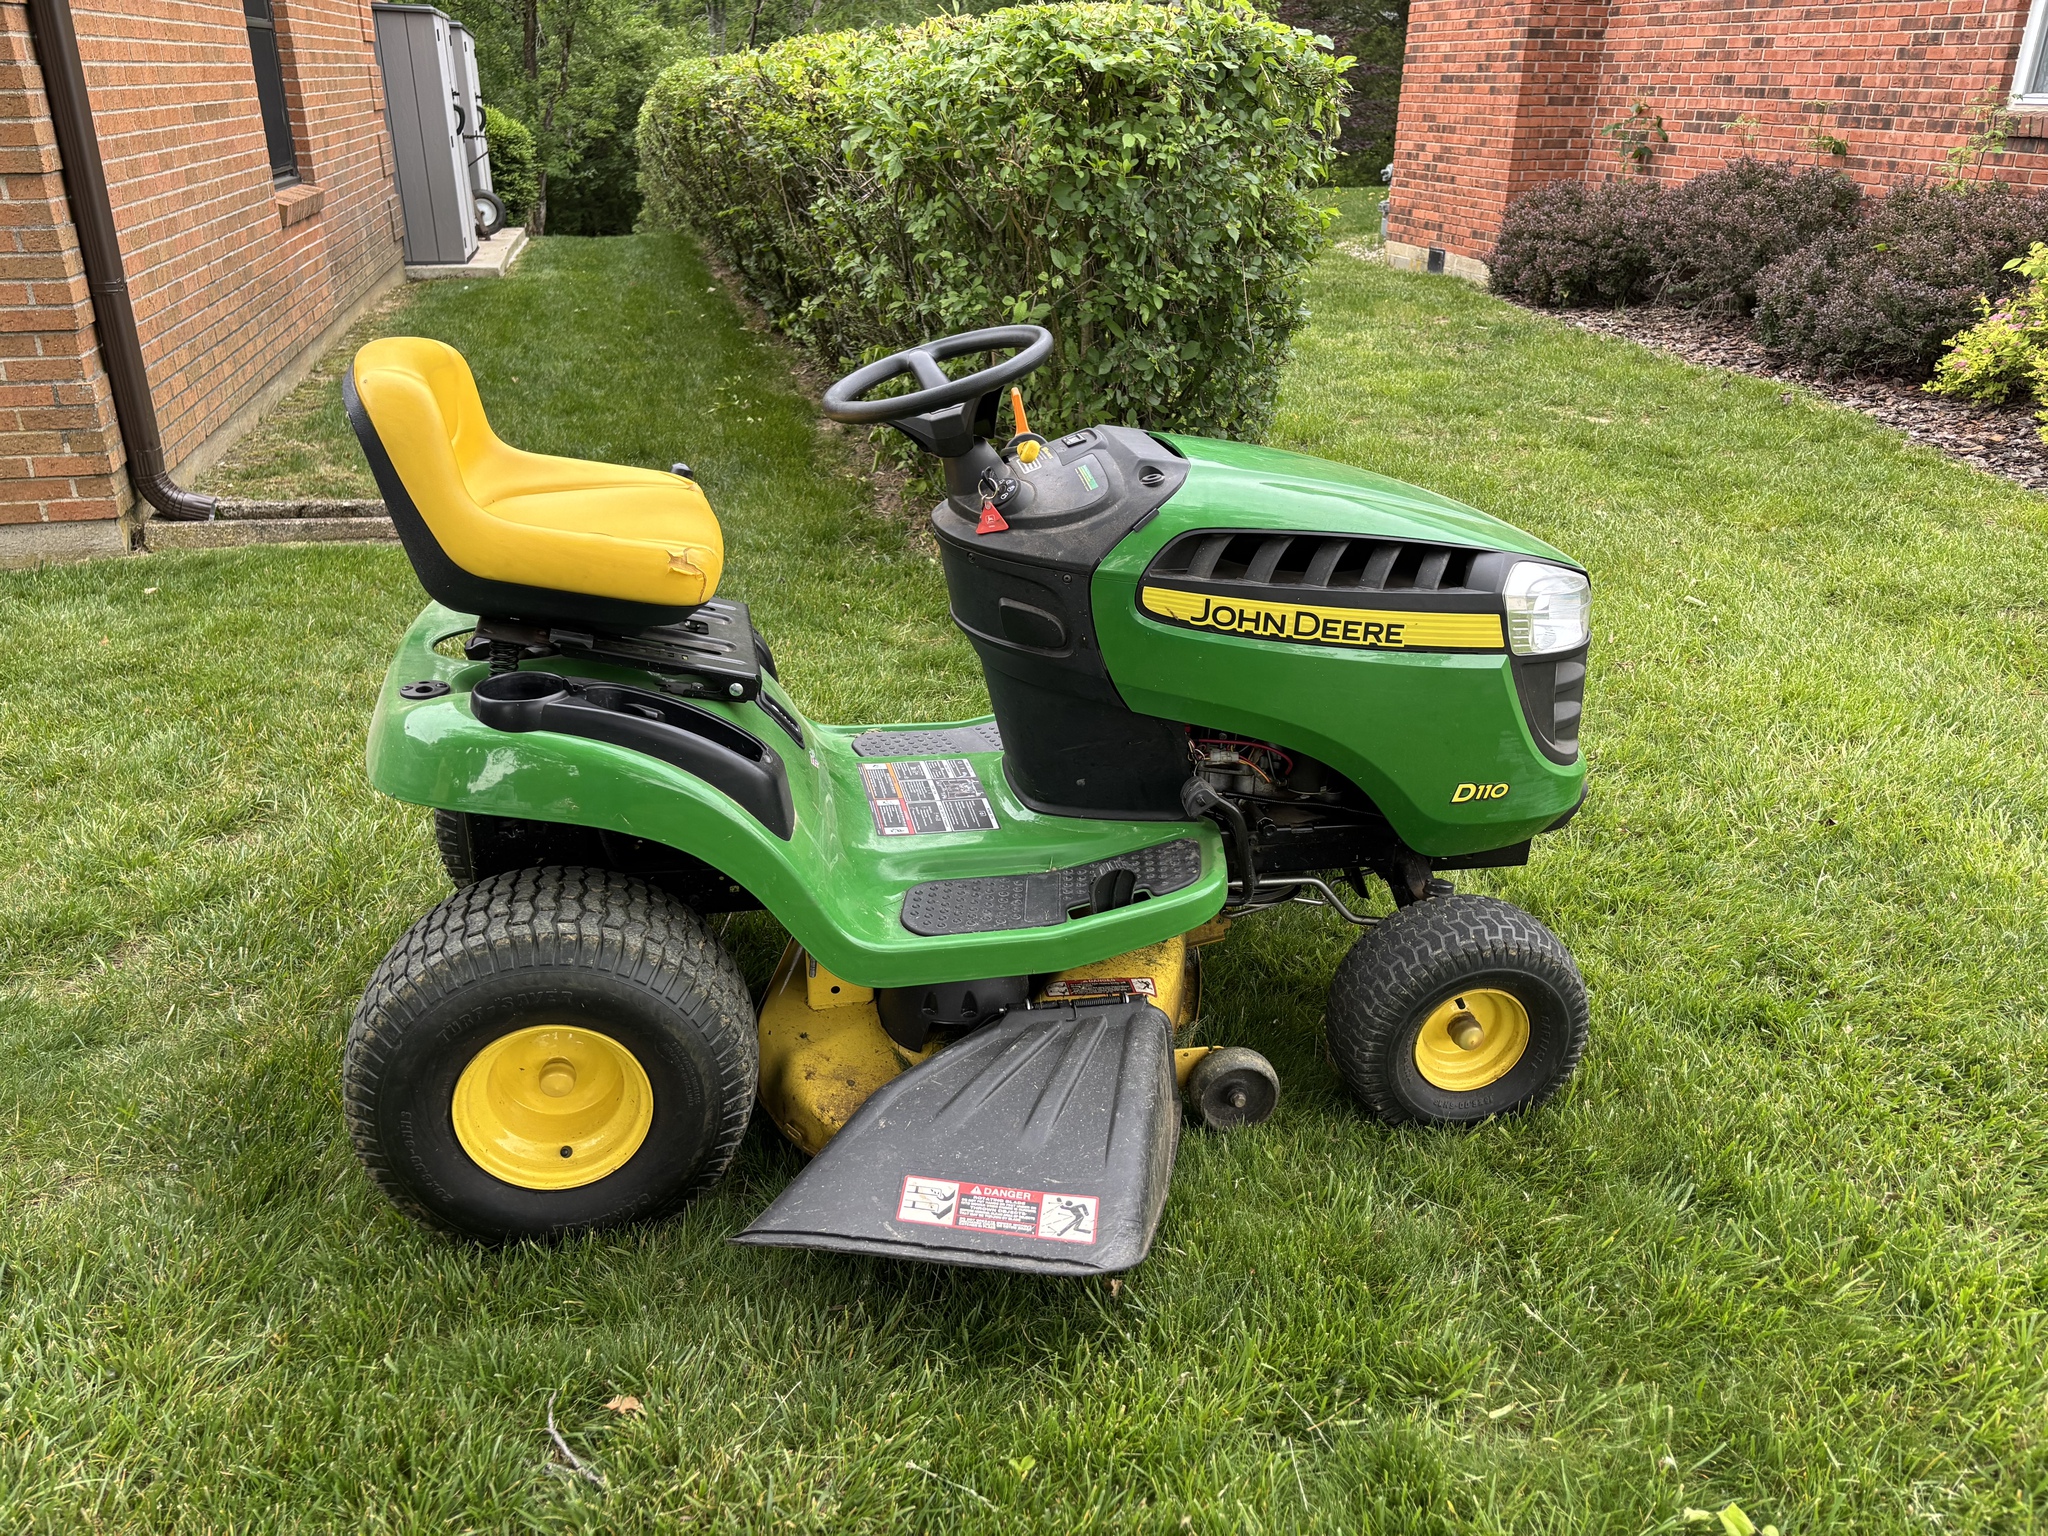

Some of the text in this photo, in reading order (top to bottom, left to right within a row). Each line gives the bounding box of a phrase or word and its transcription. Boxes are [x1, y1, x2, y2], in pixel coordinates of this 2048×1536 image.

[1190, 599, 1404, 643] JOHN DEERE
[1450, 782, 1510, 804] D110
[984, 1187, 1031, 1200] DANGER
